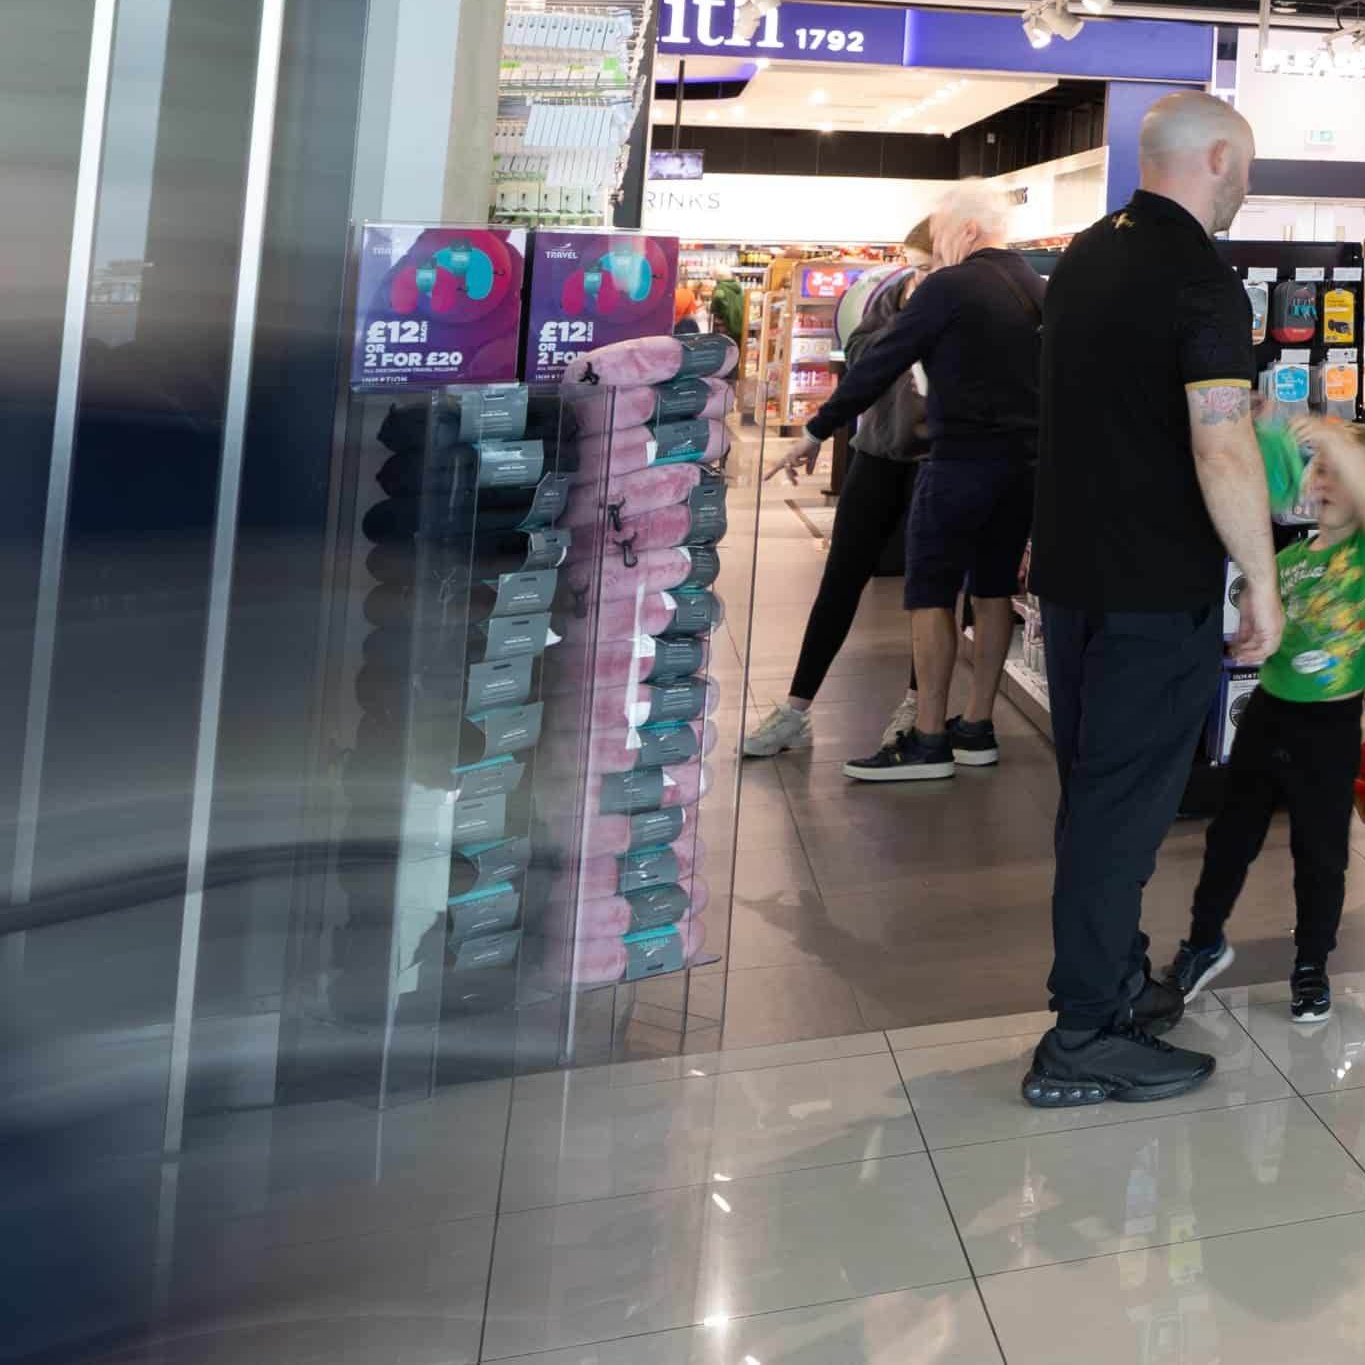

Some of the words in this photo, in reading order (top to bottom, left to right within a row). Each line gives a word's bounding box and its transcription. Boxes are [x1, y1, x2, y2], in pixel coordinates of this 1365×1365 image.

[795, 28, 864, 52] 1792
[545, 251, 579, 259] TRAVEL
[366, 320, 420, 343] £12
[538, 321, 587, 342] £12
[365, 343, 386, 354] OR
[538, 342, 556, 352] OR
[364, 354, 377, 367] 2
[381, 352, 423, 367] FOR
[425, 351, 463, 366] £20
[537, 352, 549, 365] 2
